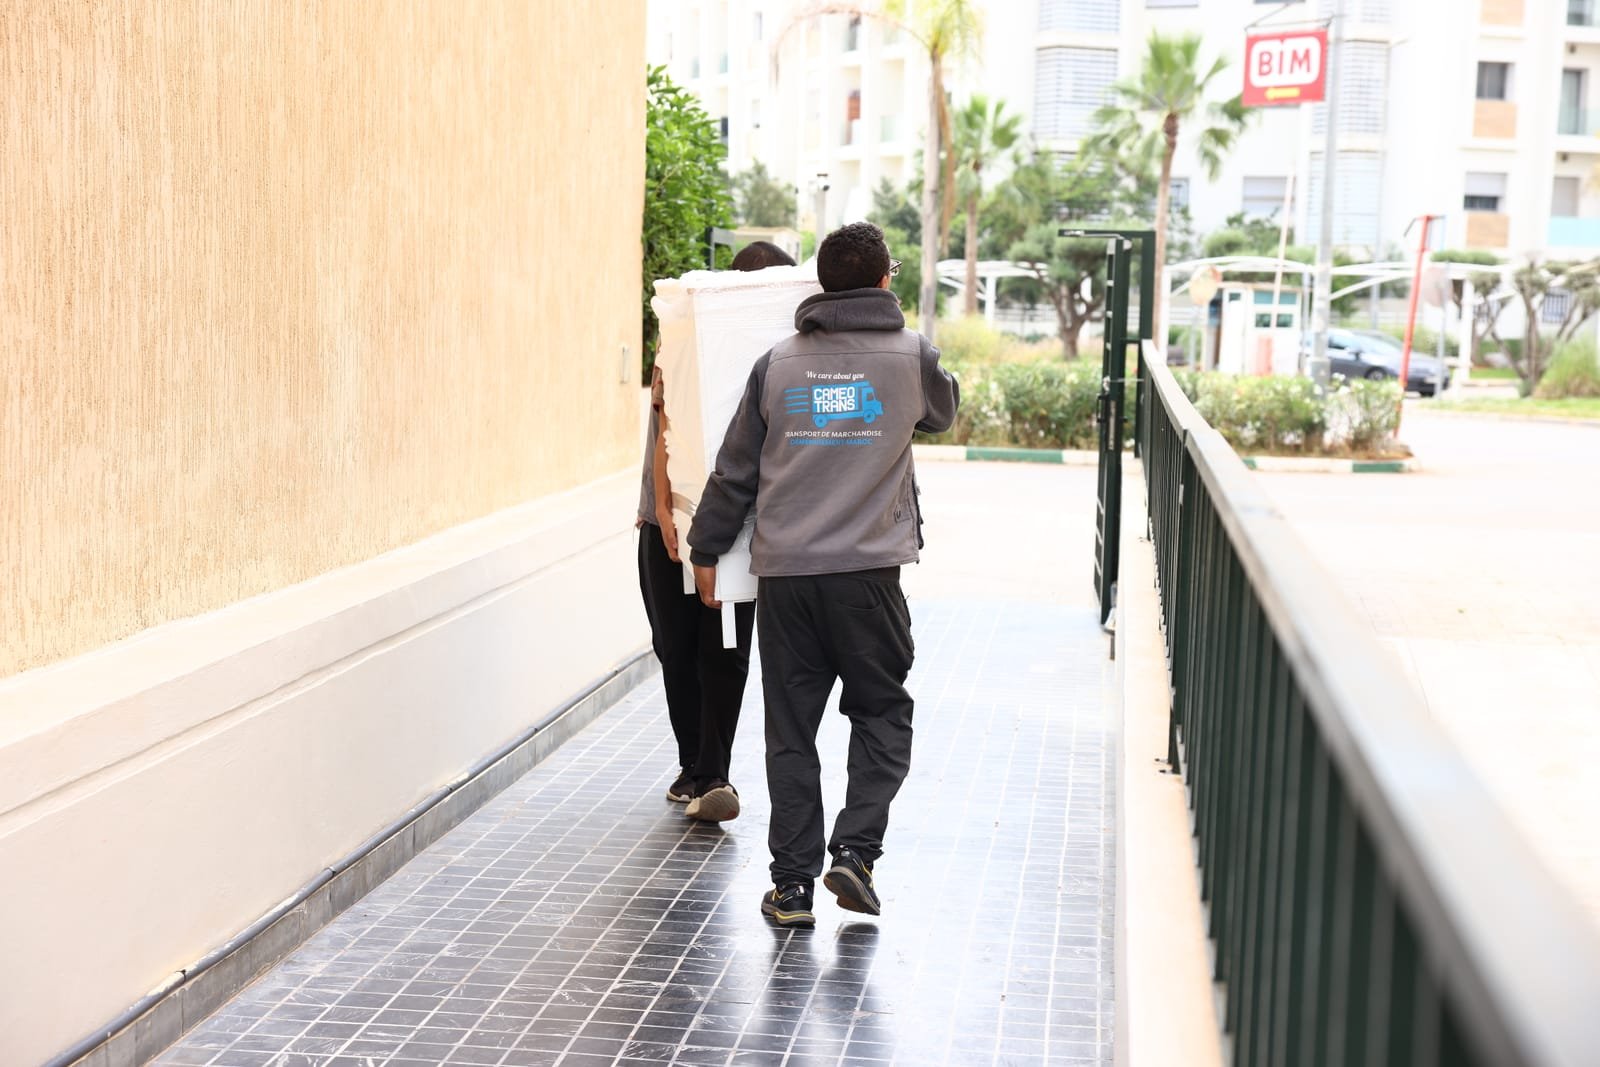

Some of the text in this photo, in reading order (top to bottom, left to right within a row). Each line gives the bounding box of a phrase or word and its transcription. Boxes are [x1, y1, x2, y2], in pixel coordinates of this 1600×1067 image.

[1258, 47, 1311, 76] BIM
[804, 370, 817, 379] We
[832, 372, 851, 380] about
[851, 373, 865, 381] you
[813, 386, 855, 400] CAMEO
[814, 399, 855, 413] TRANS
[831, 430, 883, 438] MARCHANDISE
